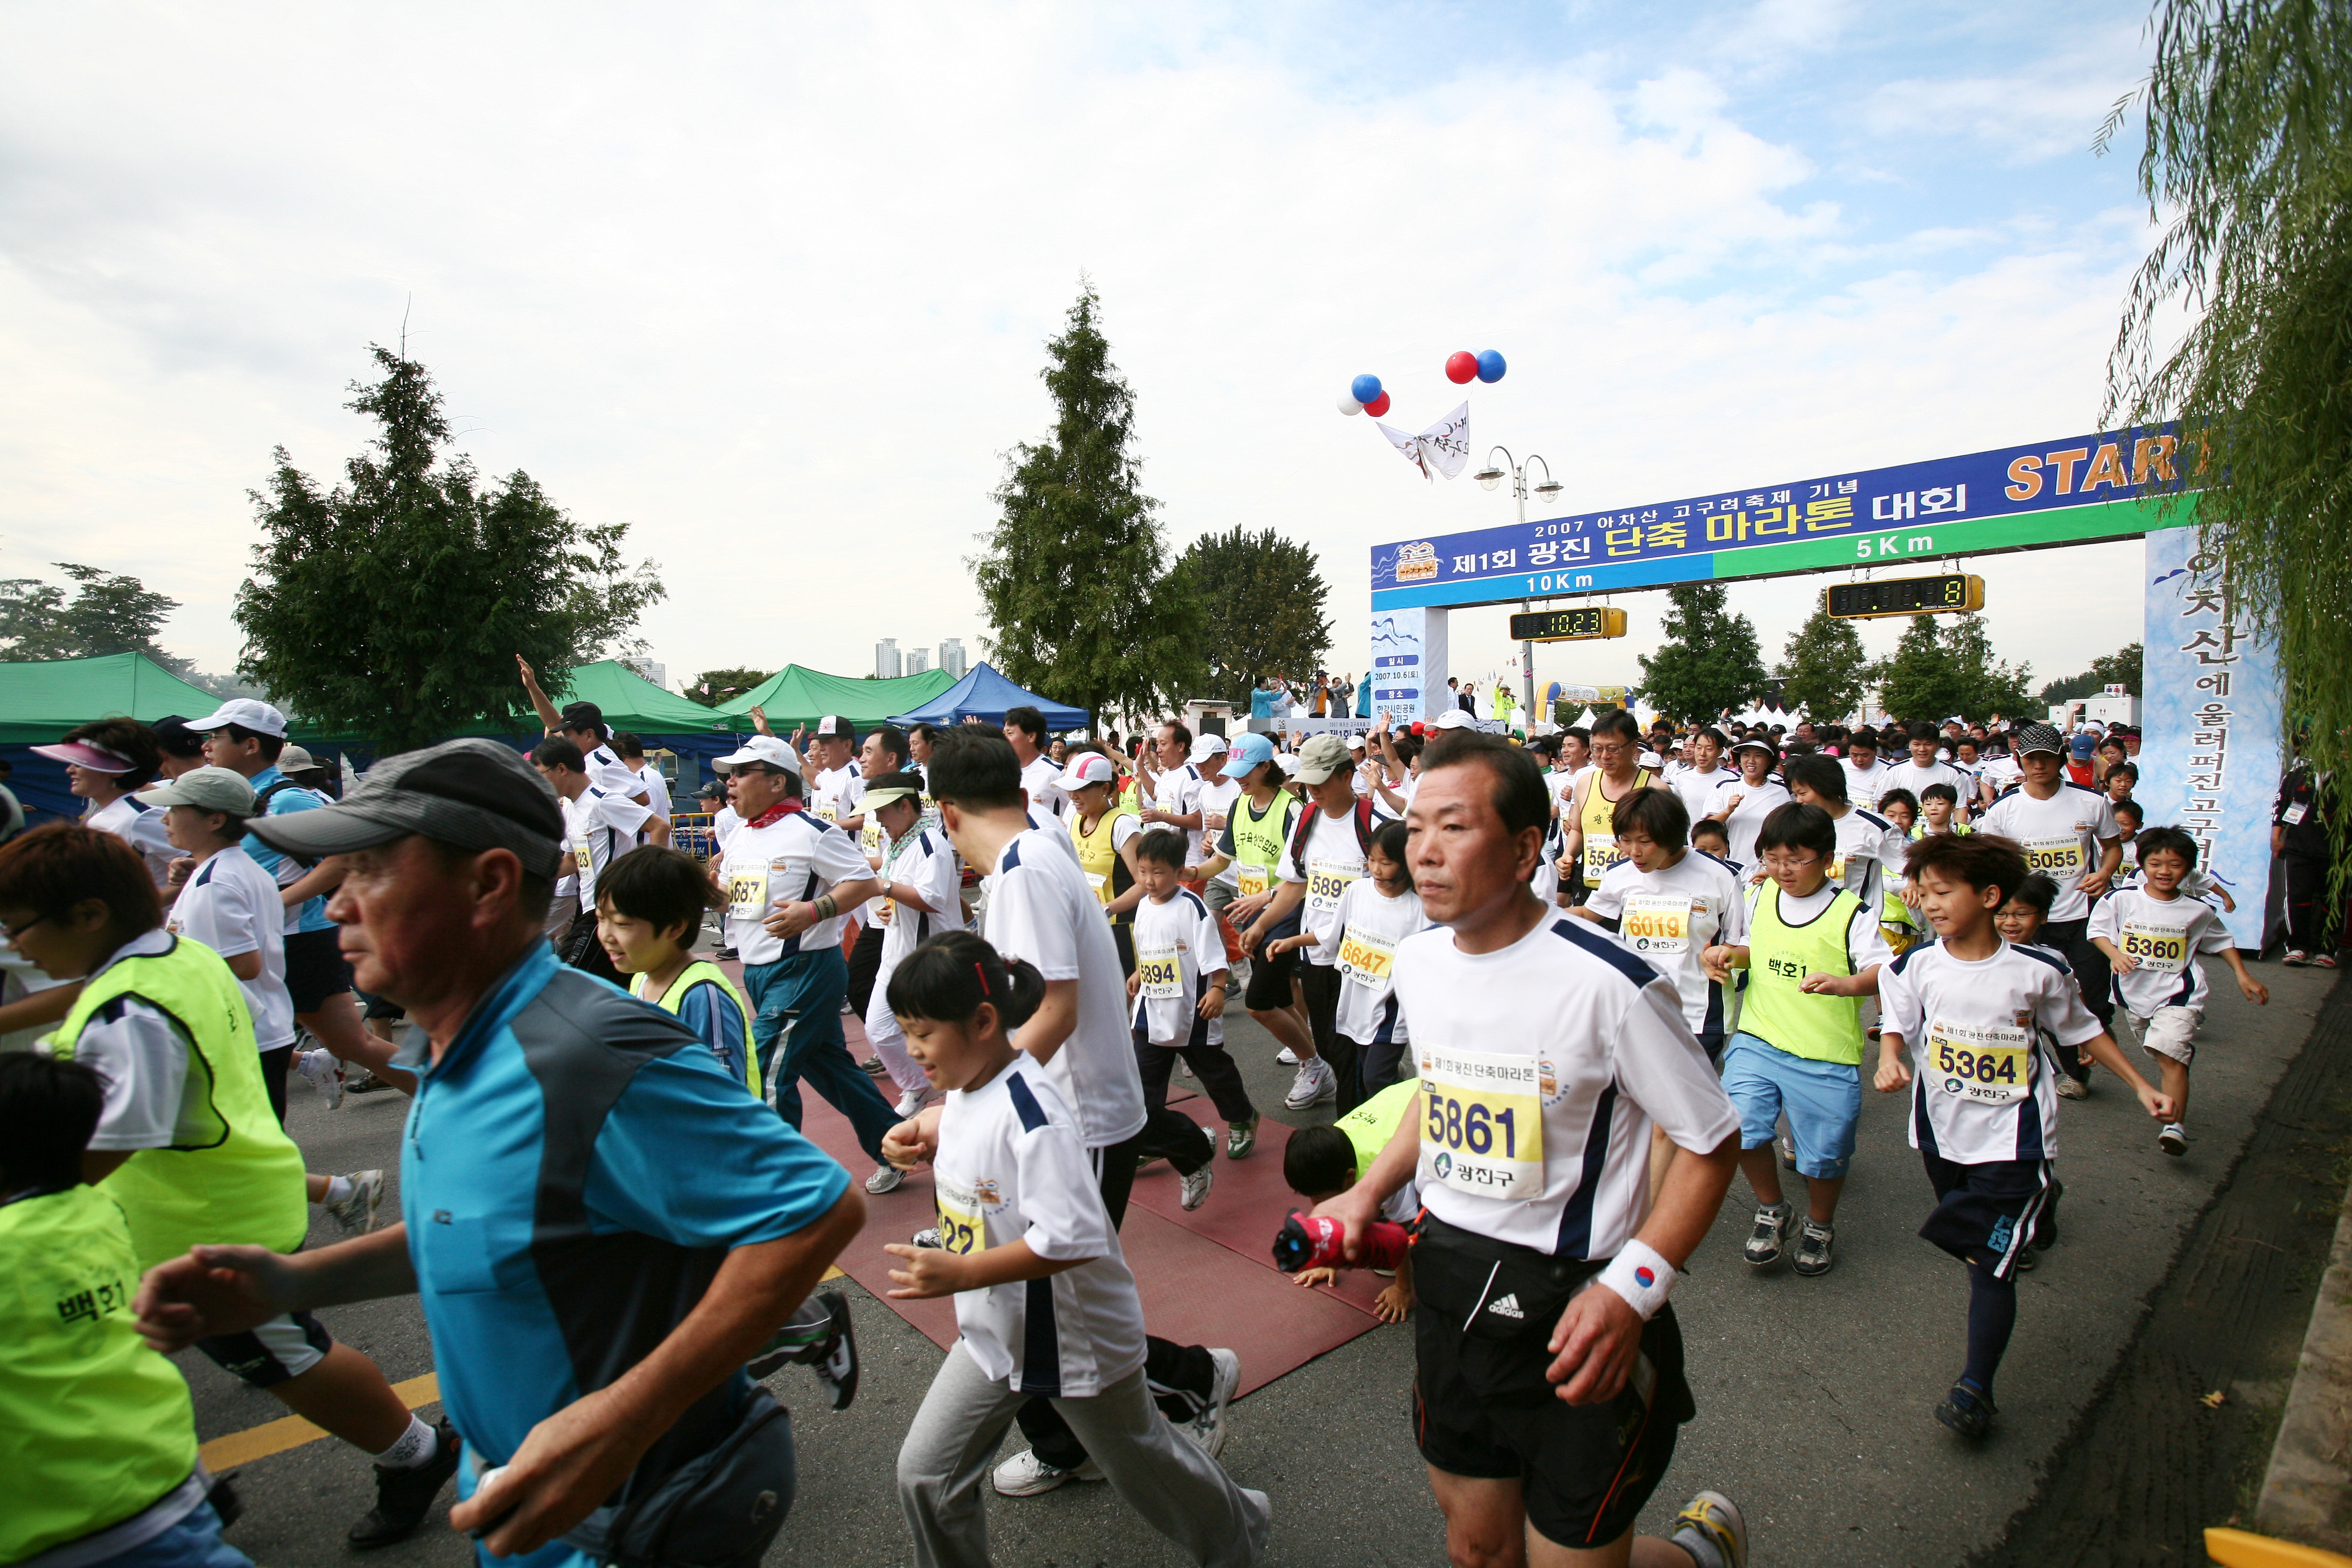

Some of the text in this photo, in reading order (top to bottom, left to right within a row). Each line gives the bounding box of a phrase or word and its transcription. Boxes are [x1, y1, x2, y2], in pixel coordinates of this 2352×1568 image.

[1535, 479, 1858, 537] 2007 아차산 고구려축제 기념
[1452, 484, 1966, 573] 제1회 광진 단축 마라톤 대회
[1856, 535, 1933, 558] 5Km
[1527, 573, 1593, 592] 10Km
[1388, 656, 1404, 666] 일시
[1388, 690, 1404, 699] 장소
[1078, 849, 1096, 862] 진구
[2029, 850, 2077, 869] 5055
[1629, 915, 1679, 937] 6019
[2126, 936, 2179, 959] 5360
[1342, 942, 1387, 974] 6647
[2146, 961, 2173, 969] 광진구
[1140, 963, 1175, 984] 5894
[1353, 970, 1376, 984] 광진구
[1768, 958, 1807, 979] 백호1
[1152, 987, 1173, 995] 광진구
[1947, 1026, 1966, 1038] 제1회
[1474, 1065, 1535, 1082] 단축마라톤
[1939, 1045, 2017, 1084] 5364
[1967, 1085, 2011, 1100] 광진구
[1428, 1094, 1515, 1158] 5861
[1457, 1163, 1516, 1187] 광진구
[1488, 1304, 1524, 1319] adidas
